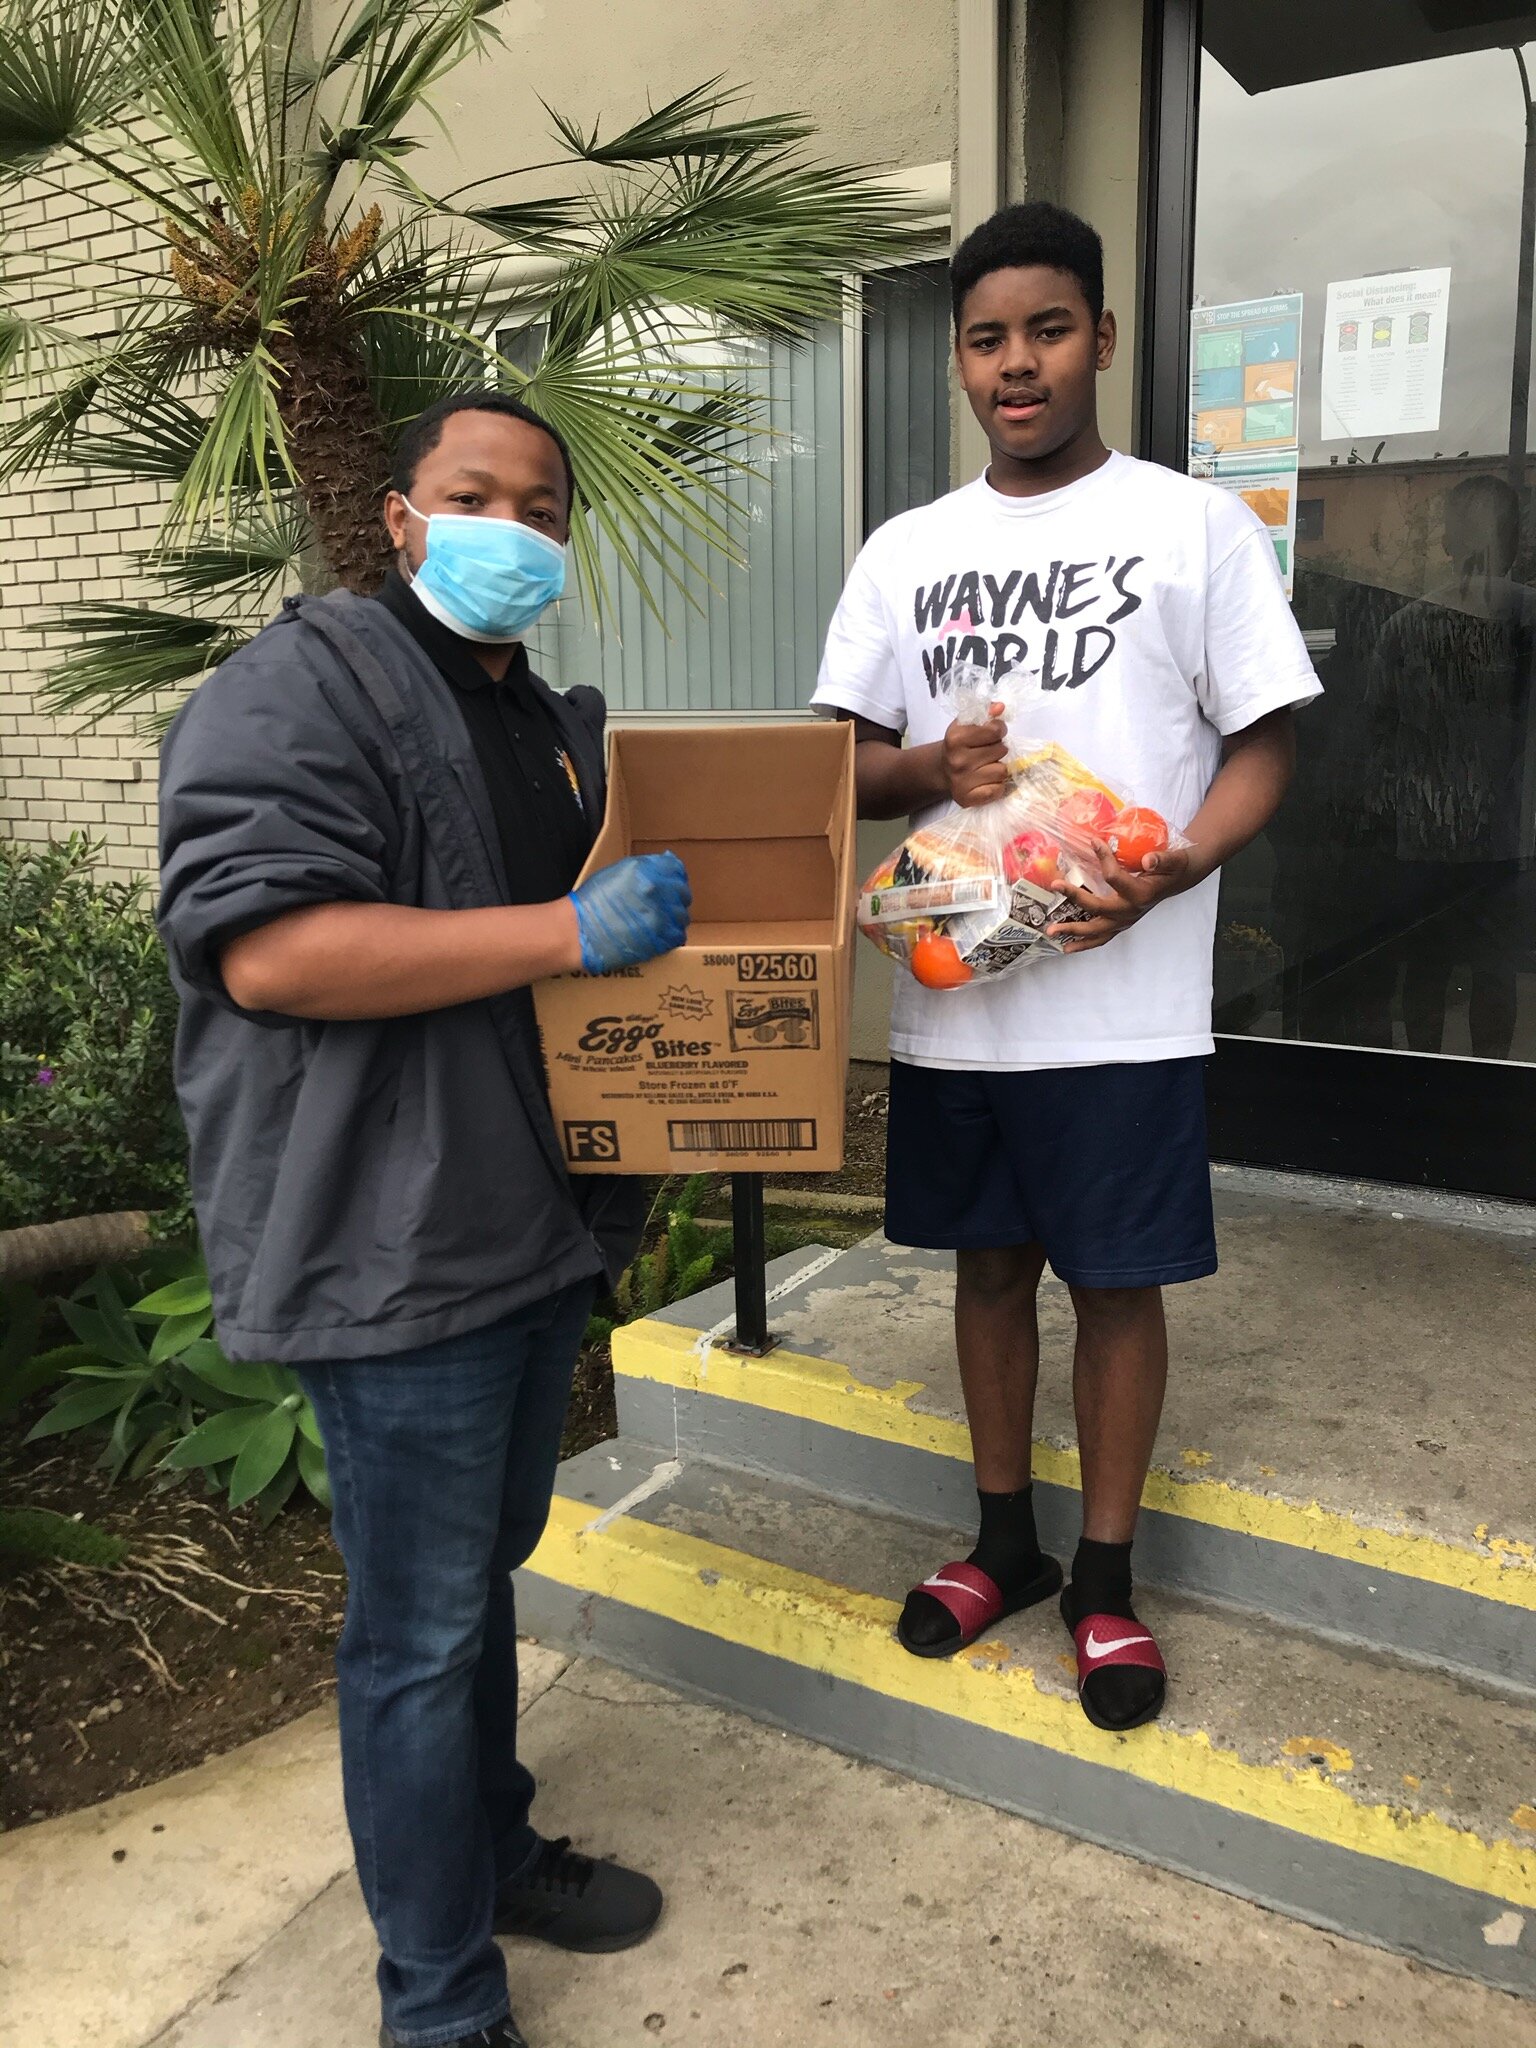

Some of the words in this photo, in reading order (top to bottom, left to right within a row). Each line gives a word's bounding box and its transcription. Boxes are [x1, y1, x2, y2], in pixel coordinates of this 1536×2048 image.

[1336, 287, 1364, 300] Social
[1363, 296, 1384, 307] What
[1385, 295, 1404, 304] does
[1406, 293, 1414, 302] it
[1414, 289, 1442, 301] mean?
[1216, 312, 1229, 321] STOP
[1230, 311, 1241, 319] THE
[1241, 307, 1261, 318] SPREAD
[1262, 306, 1269, 314] OF
[1269, 303, 1289, 314] GERMS
[914, 555, 1144, 634] WAYNE'S
[702, 954, 736, 967] 38000
[740, 954, 814, 980] 92560
[578, 1015, 665, 1054] Eggo
[586, 1054, 643, 1065] Pancakes
[645, 1061, 699, 1069] BLUEBERRY
[701, 1060, 750, 1069] FLAVORED
[638, 1080, 668, 1090] Store
[670, 1080, 706, 1090] Frozen
[709, 1080, 720, 1089] at
[567, 1126, 617, 1159] FS
